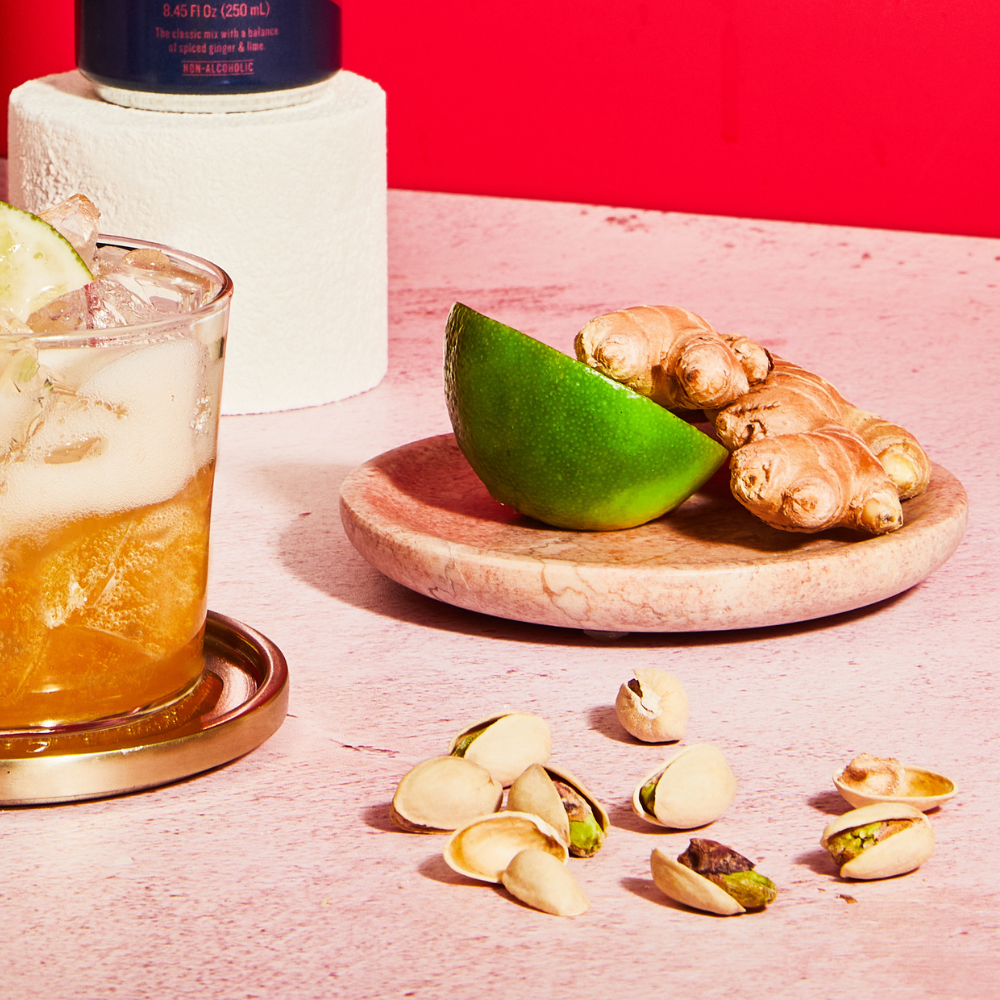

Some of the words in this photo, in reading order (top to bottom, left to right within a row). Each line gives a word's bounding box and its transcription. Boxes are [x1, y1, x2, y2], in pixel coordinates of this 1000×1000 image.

[163, 3, 188, 18] 8.45
[203, 4, 217, 18] Oz
[220, 2, 248, 19] (250
[250, 1, 271, 17] mL)
[155, 27, 170, 39] The
[172, 28, 201, 39] classic
[203, 29, 219, 39] mix
[220, 28, 239, 39] with
[247, 26, 279, 38] balance
[168, 43, 177, 53] of
[179, 43, 207, 55] spiced
[208, 44, 236, 56] ginger
[238, 41, 245, 53] &
[182, 62, 254, 73] NON-ALCOHOLIC
